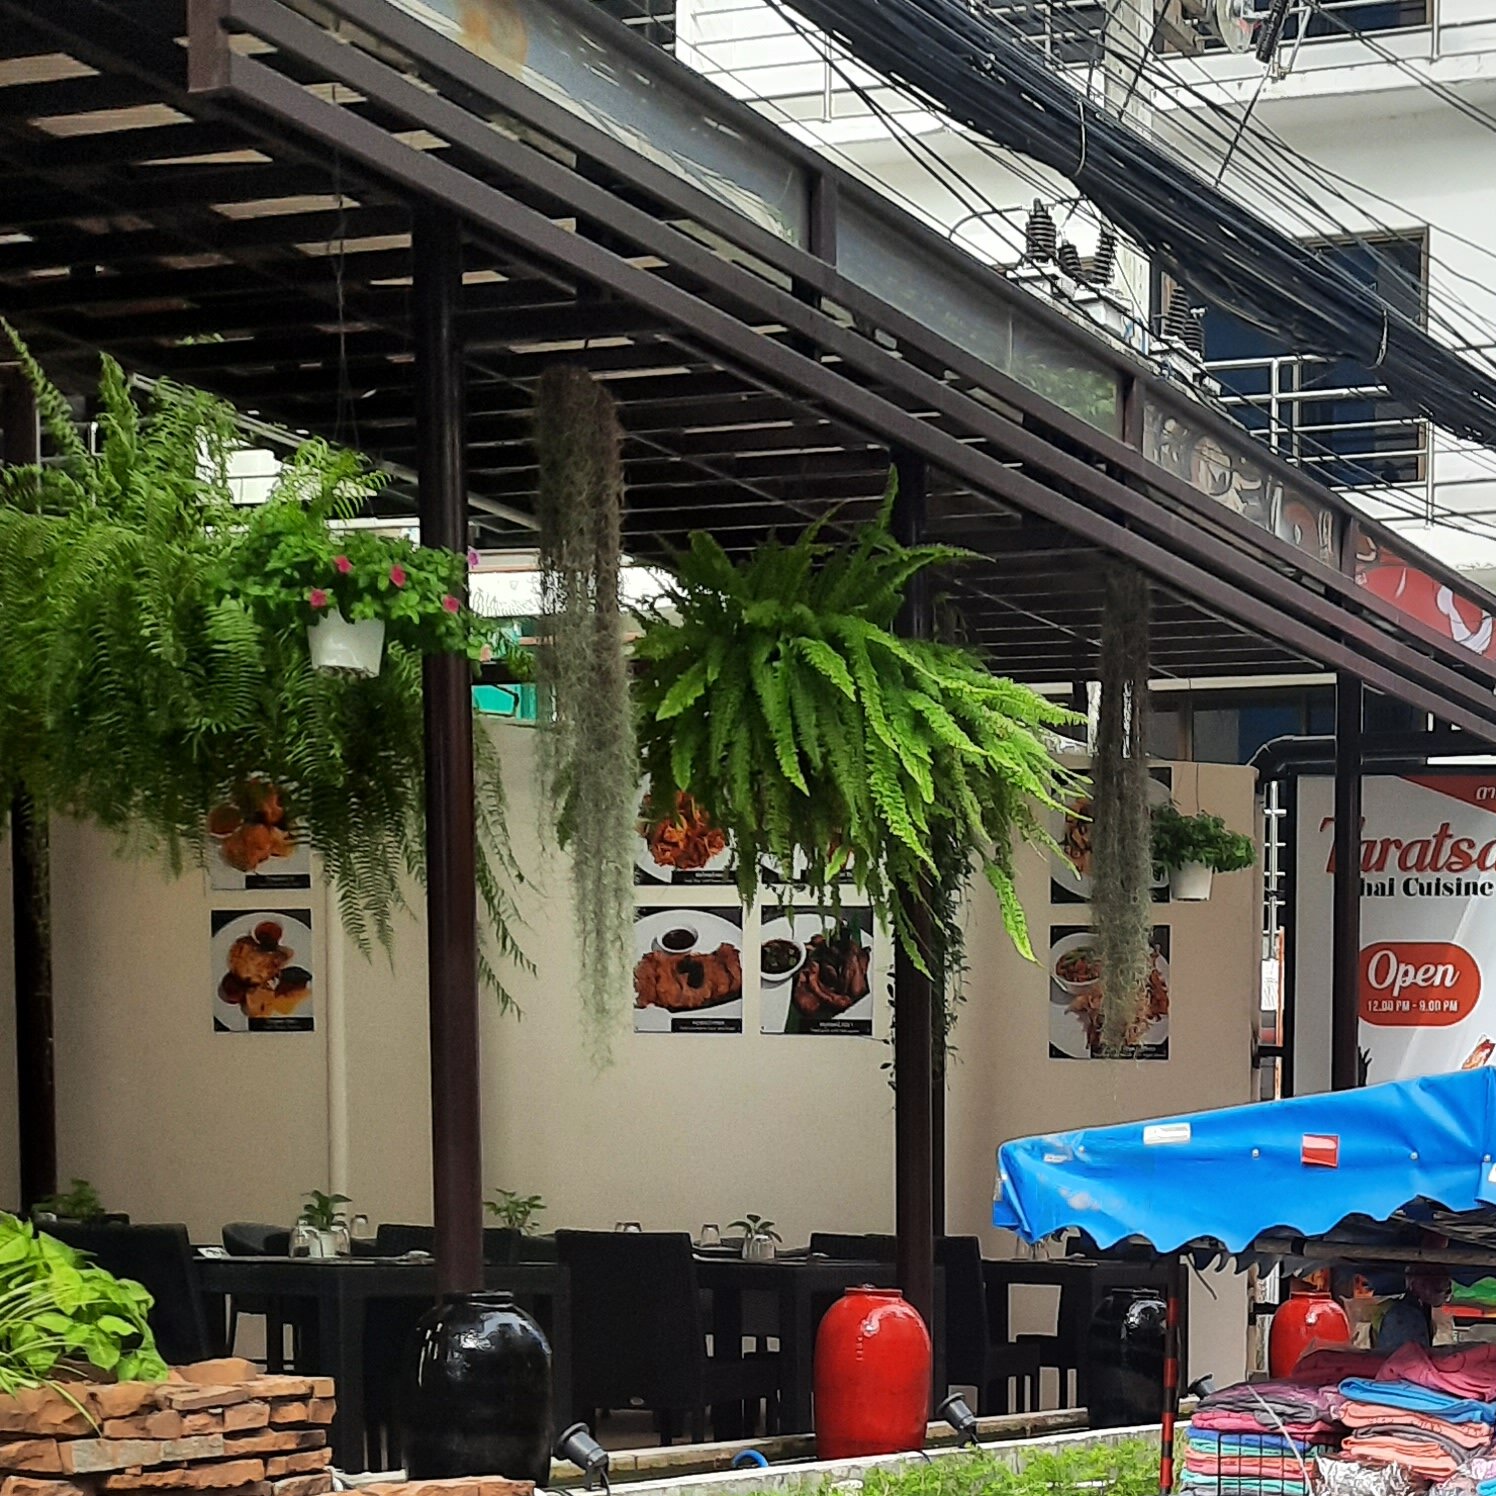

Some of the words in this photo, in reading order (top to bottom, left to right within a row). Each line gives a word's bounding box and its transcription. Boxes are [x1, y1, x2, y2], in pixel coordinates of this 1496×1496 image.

[1360, 876, 1395, 897] hai
[1402, 876, 1495, 898] Cuisine
[1367, 949, 1461, 997] Open
[1368, 1000, 1394, 1012] 12.00
[1395, 1000, 1410, 1012] PM
[1443, 1000, 1458, 1012] PM
